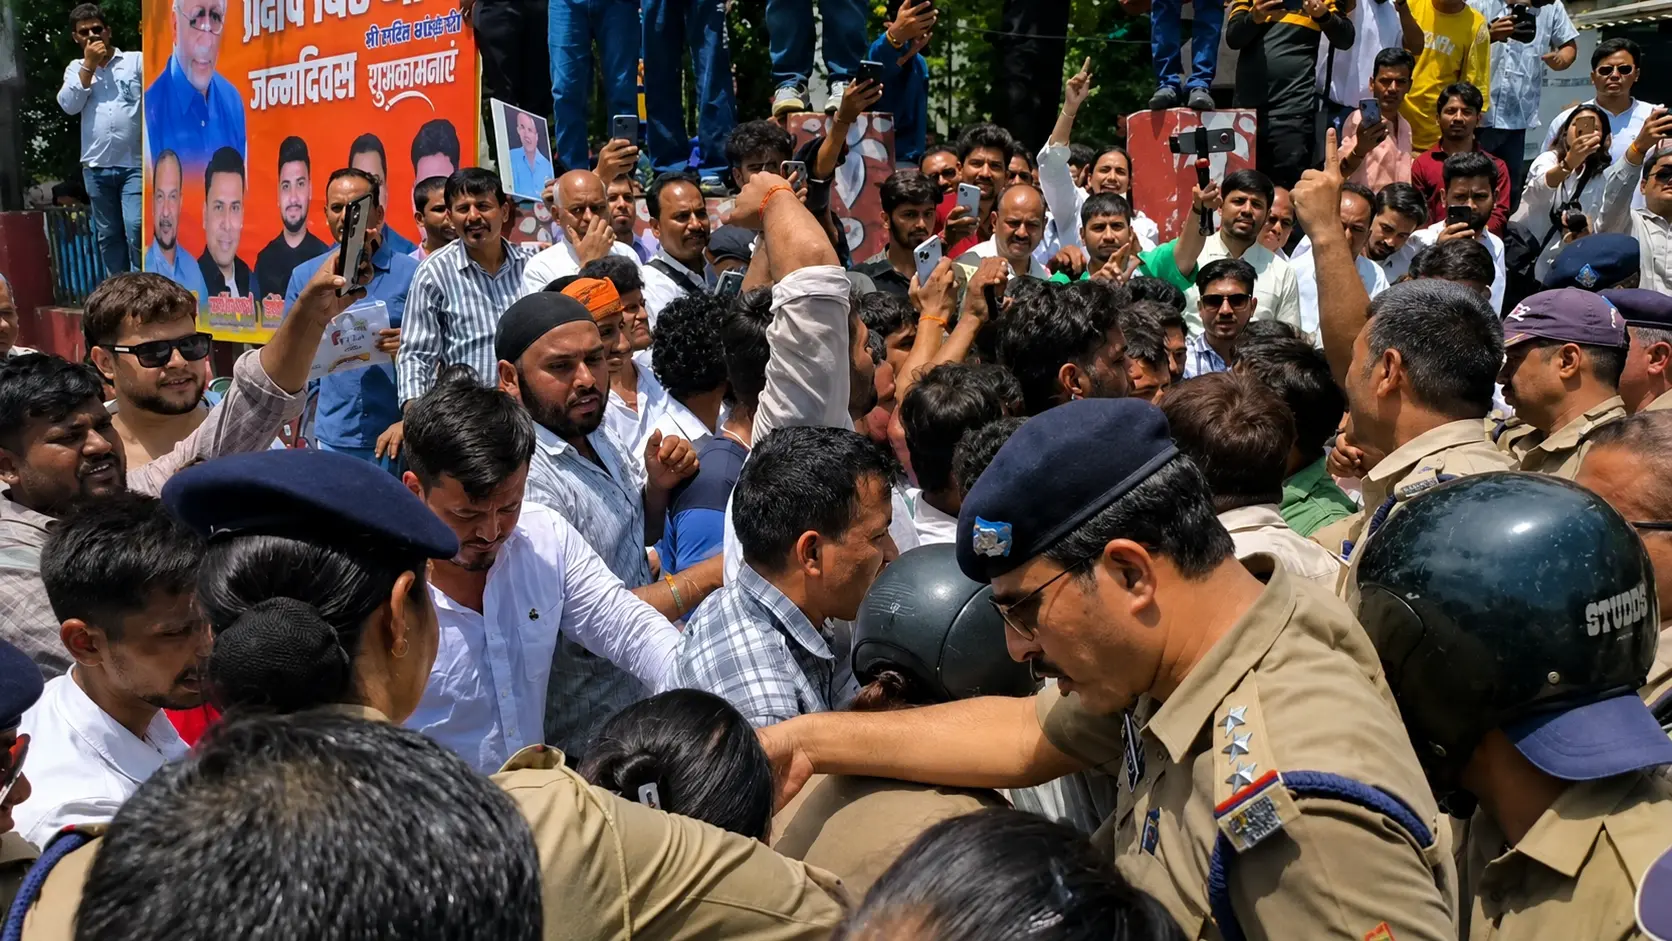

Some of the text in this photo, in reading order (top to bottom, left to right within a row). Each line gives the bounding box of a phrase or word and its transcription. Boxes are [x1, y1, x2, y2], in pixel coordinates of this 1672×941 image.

[248, 40, 459, 111] जन्मदिवस शुभकामनाएं
[1585, 583, 1648, 637] STUDDS
